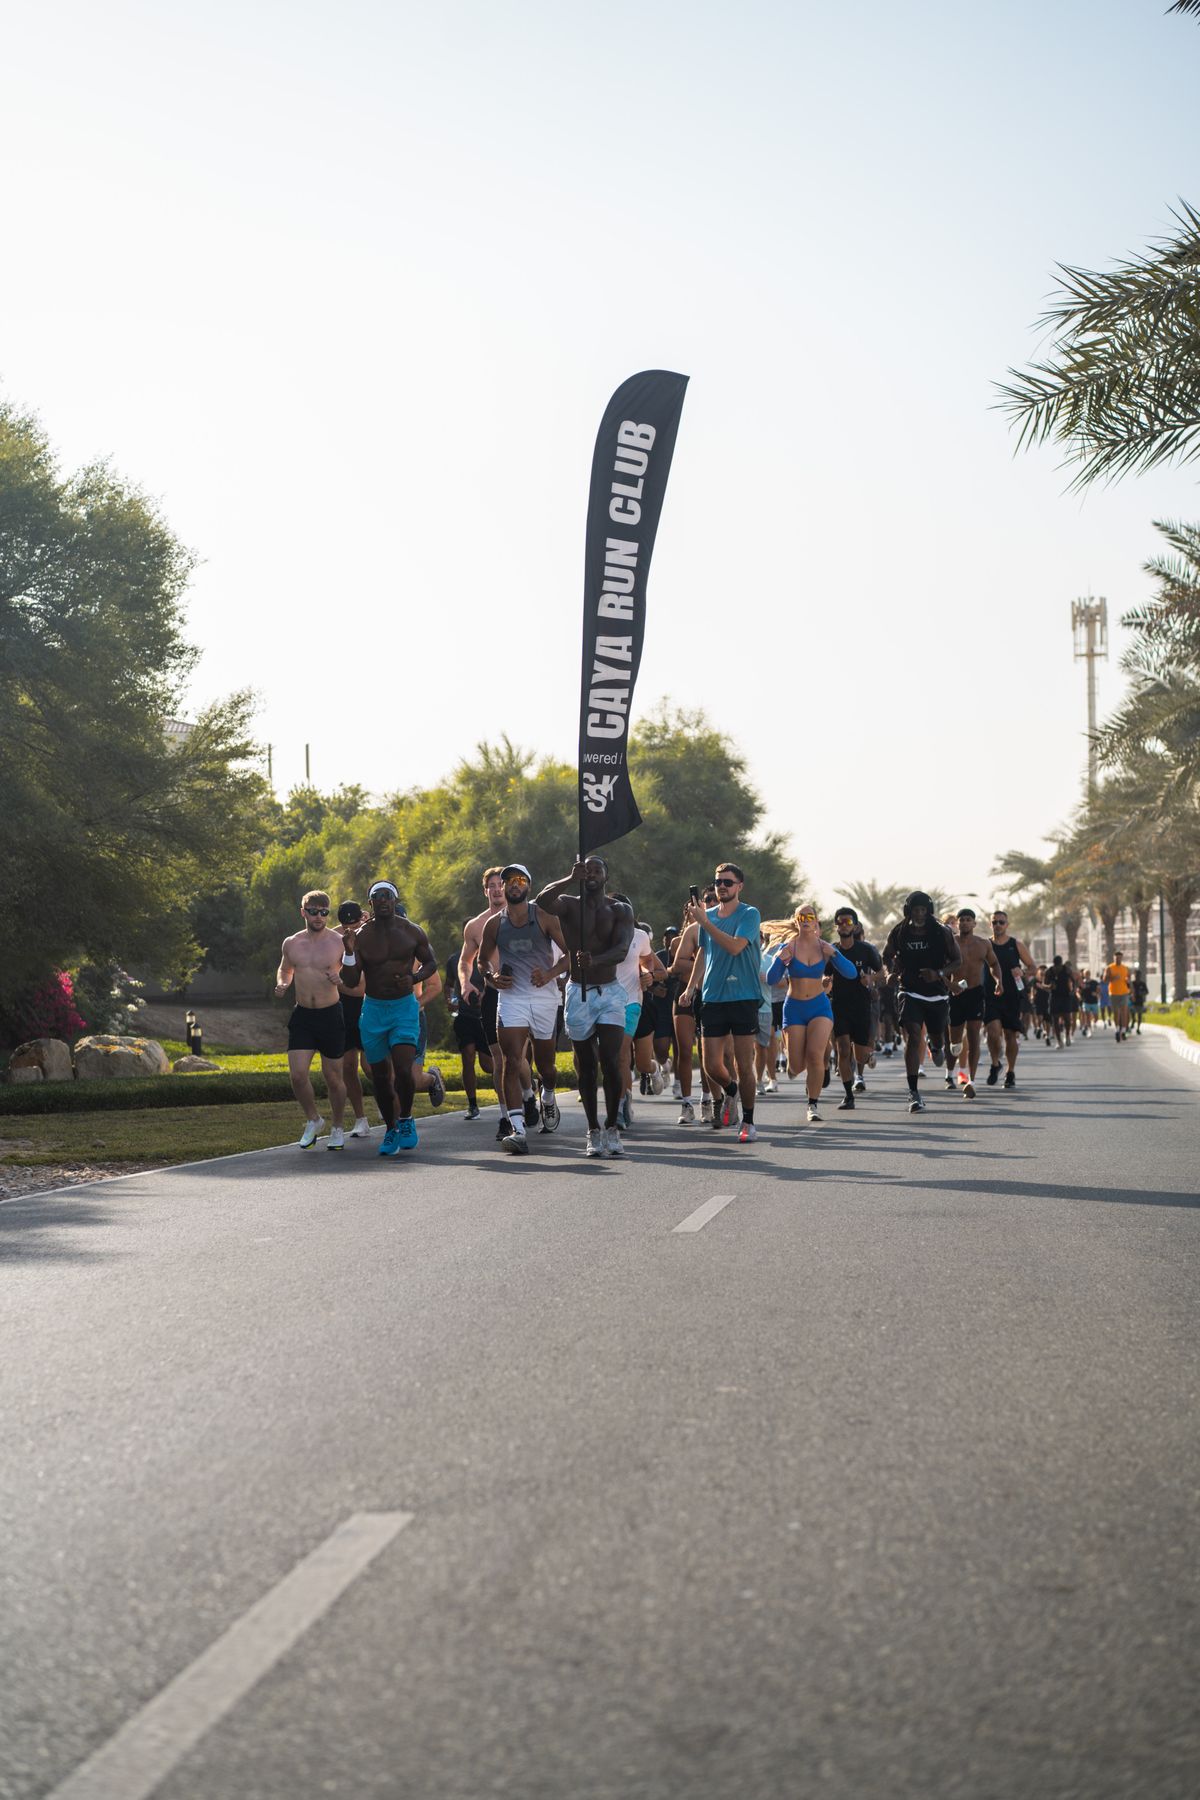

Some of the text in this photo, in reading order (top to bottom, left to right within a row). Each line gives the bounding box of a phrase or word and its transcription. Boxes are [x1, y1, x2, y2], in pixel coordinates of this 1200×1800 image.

[586, 420, 656, 739] CAYA RUN CLUB
[583, 752, 618, 765] wered
